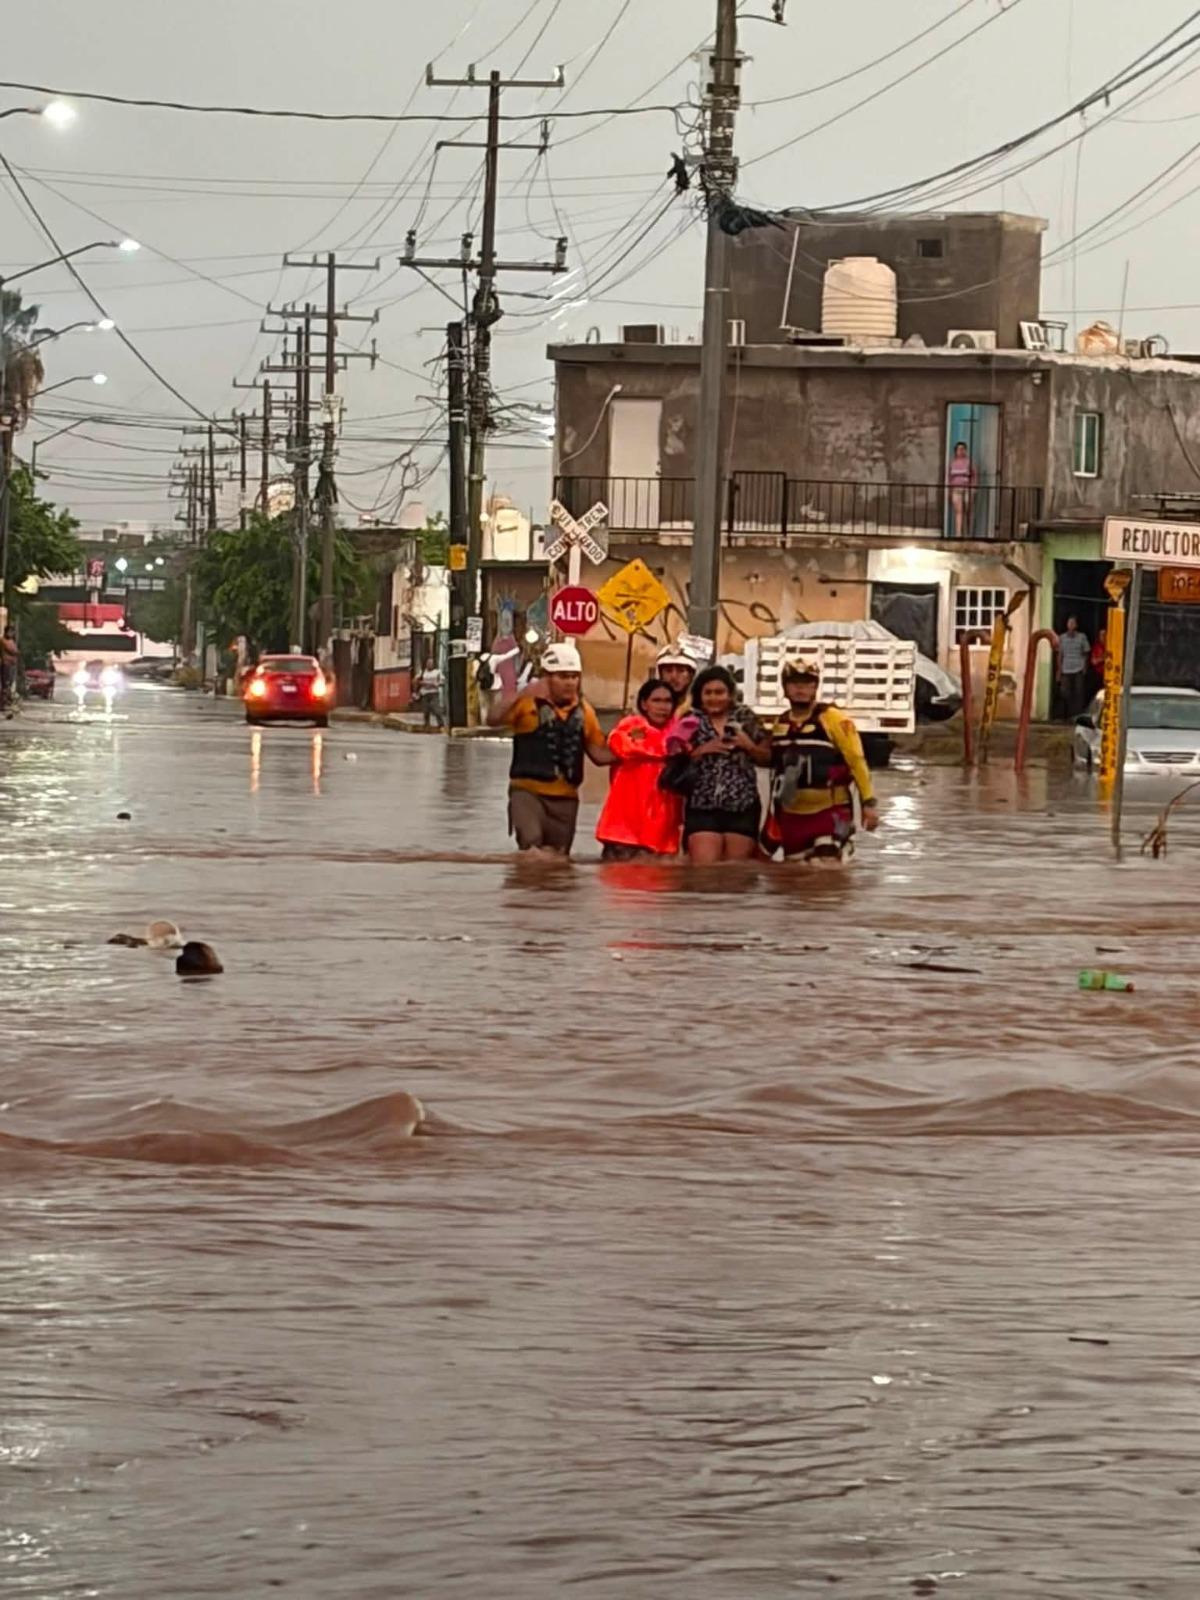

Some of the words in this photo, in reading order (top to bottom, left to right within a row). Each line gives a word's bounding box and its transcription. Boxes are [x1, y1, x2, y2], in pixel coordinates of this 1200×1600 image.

[578, 505, 605, 530] TREN
[1122, 527, 1200, 556] REDUCTOR
[554, 600, 596, 622] ALTO
